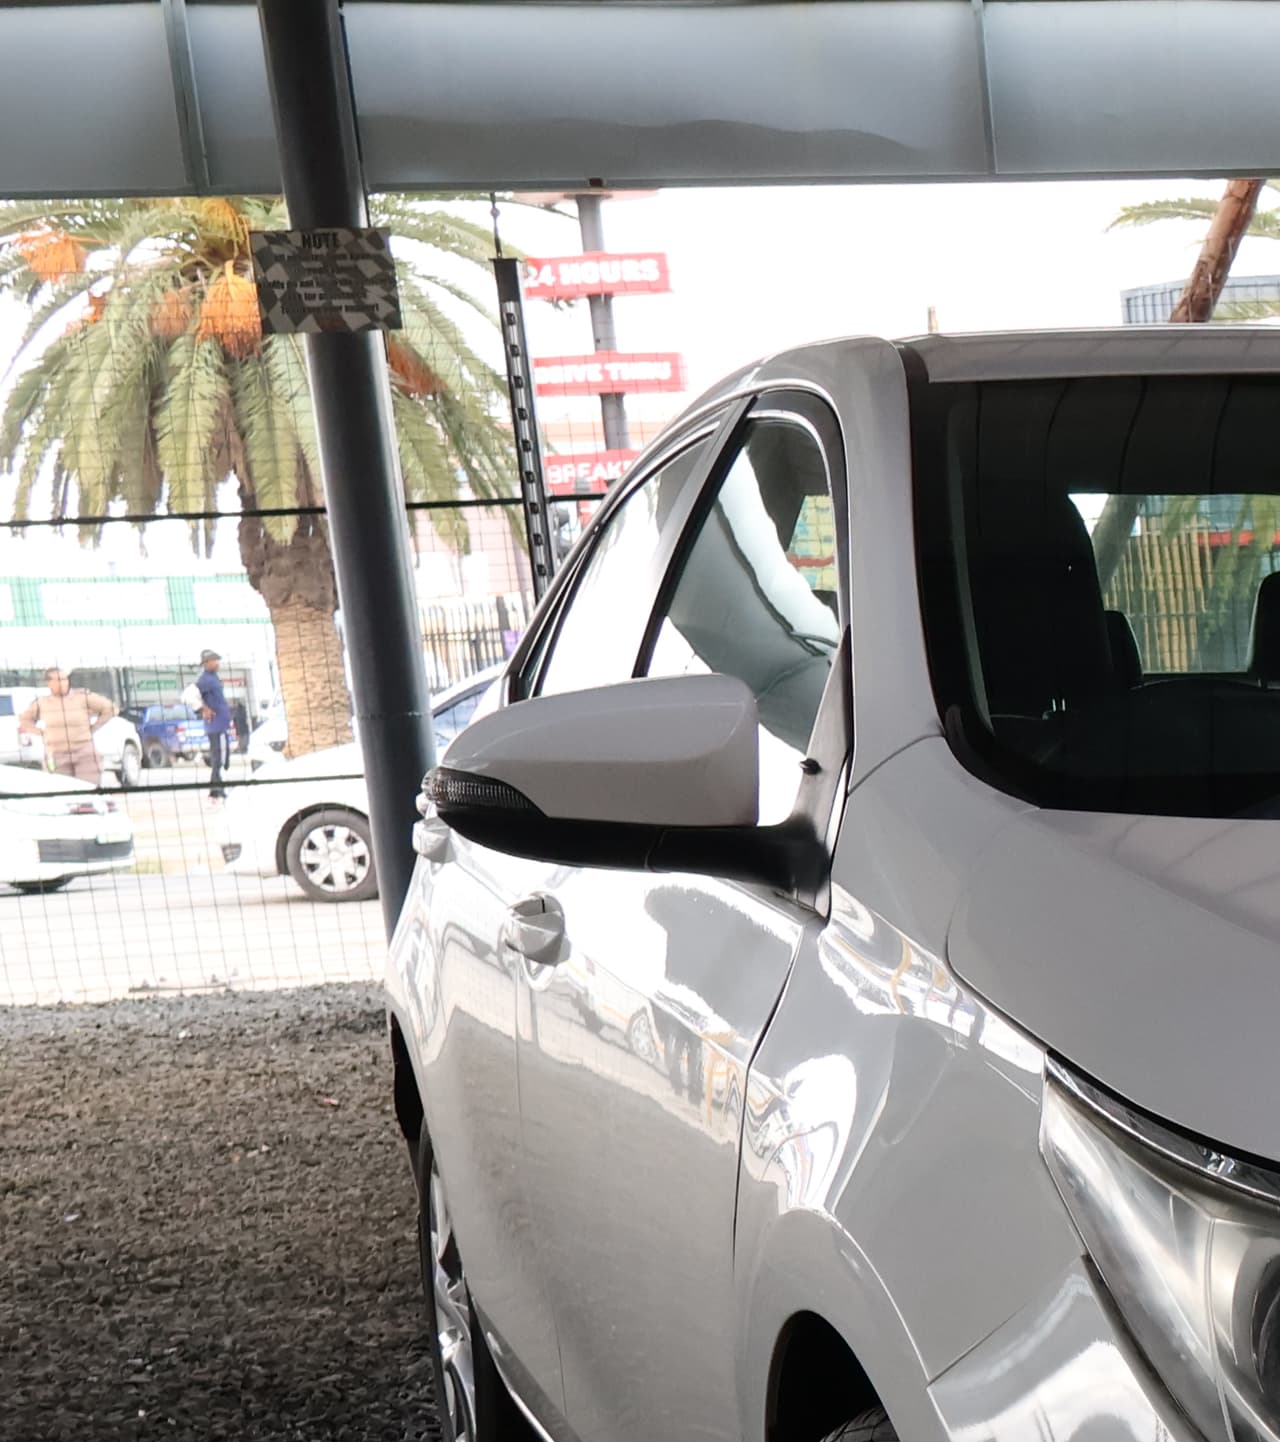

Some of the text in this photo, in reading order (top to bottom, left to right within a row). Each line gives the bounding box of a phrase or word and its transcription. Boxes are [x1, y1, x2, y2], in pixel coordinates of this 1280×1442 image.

[523, 259, 659, 287] 24 HOURS
[534, 361, 672, 385] DRIVE THRU
